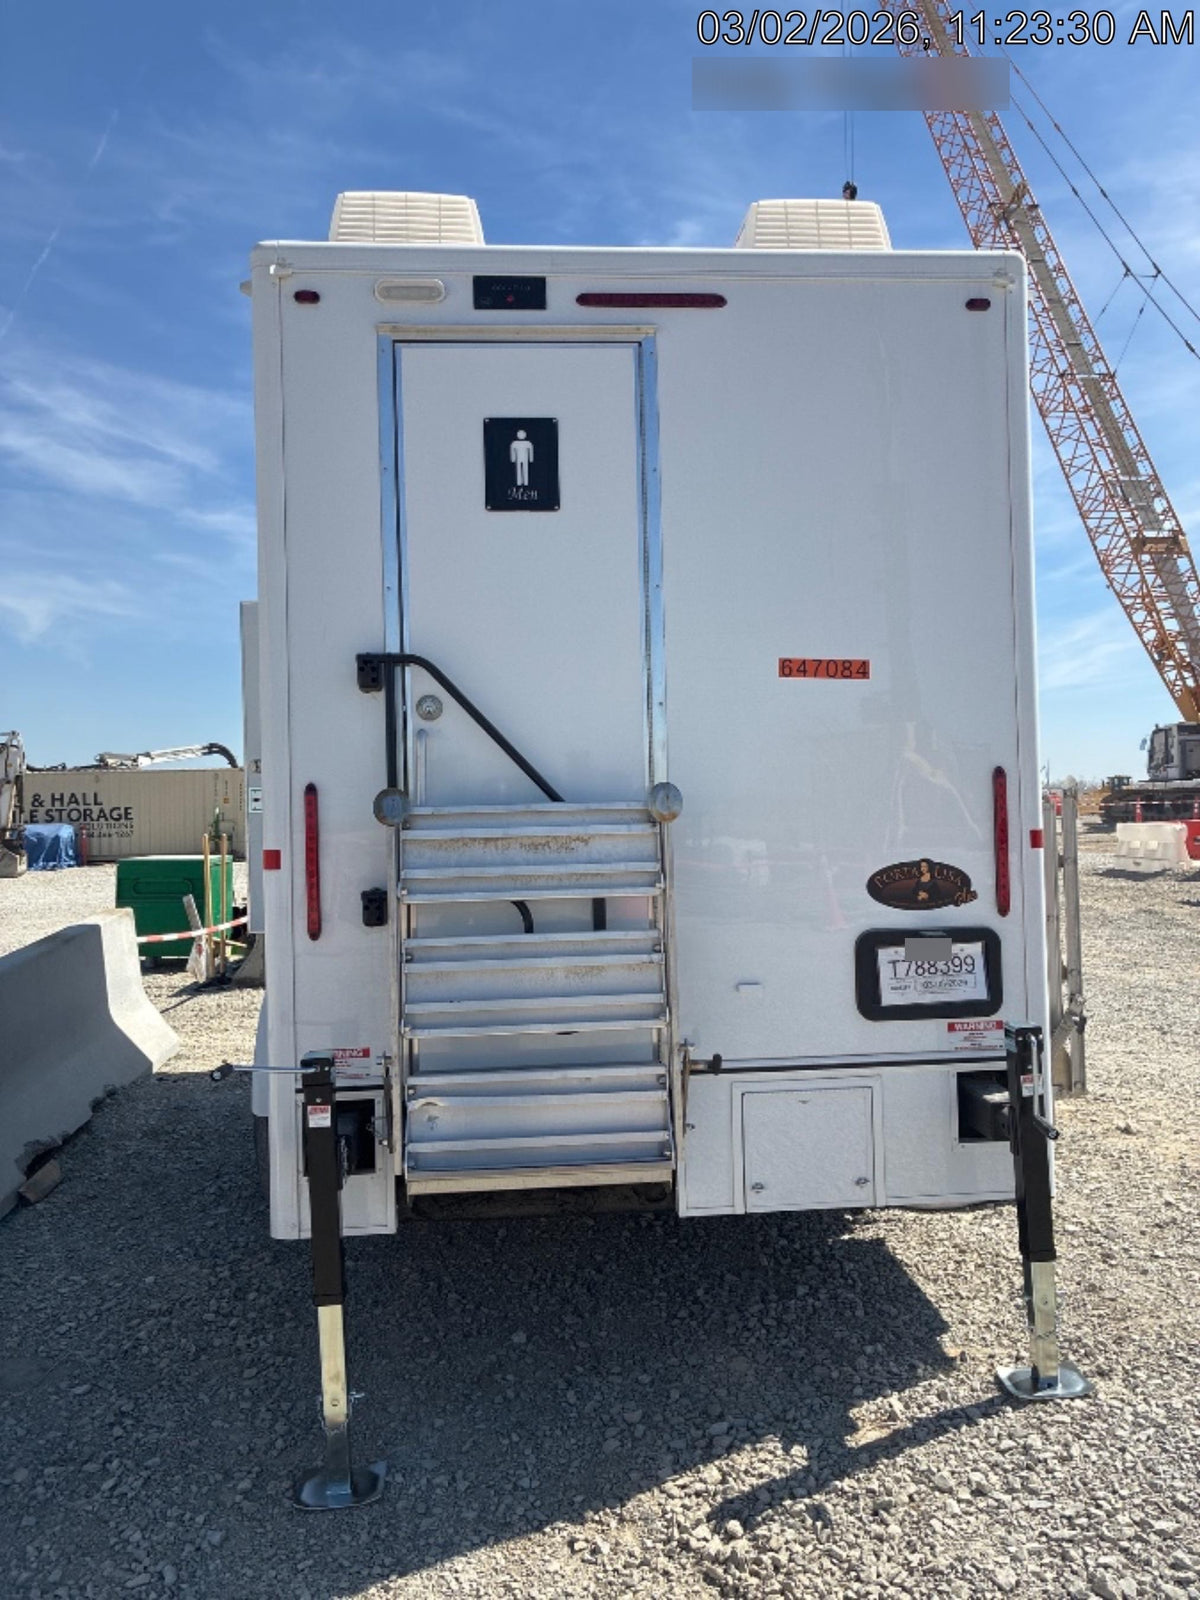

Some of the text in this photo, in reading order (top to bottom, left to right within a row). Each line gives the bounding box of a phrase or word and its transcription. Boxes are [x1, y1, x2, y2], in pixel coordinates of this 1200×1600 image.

[507, 487, 538, 500] Men
[781, 659, 868, 677] 647084
[31, 792, 103, 808] & HALL
[45, 806, 134, 822] STORAGE
[888, 954, 976, 978] T788399
[954, 1022, 997, 1030] WARNING
